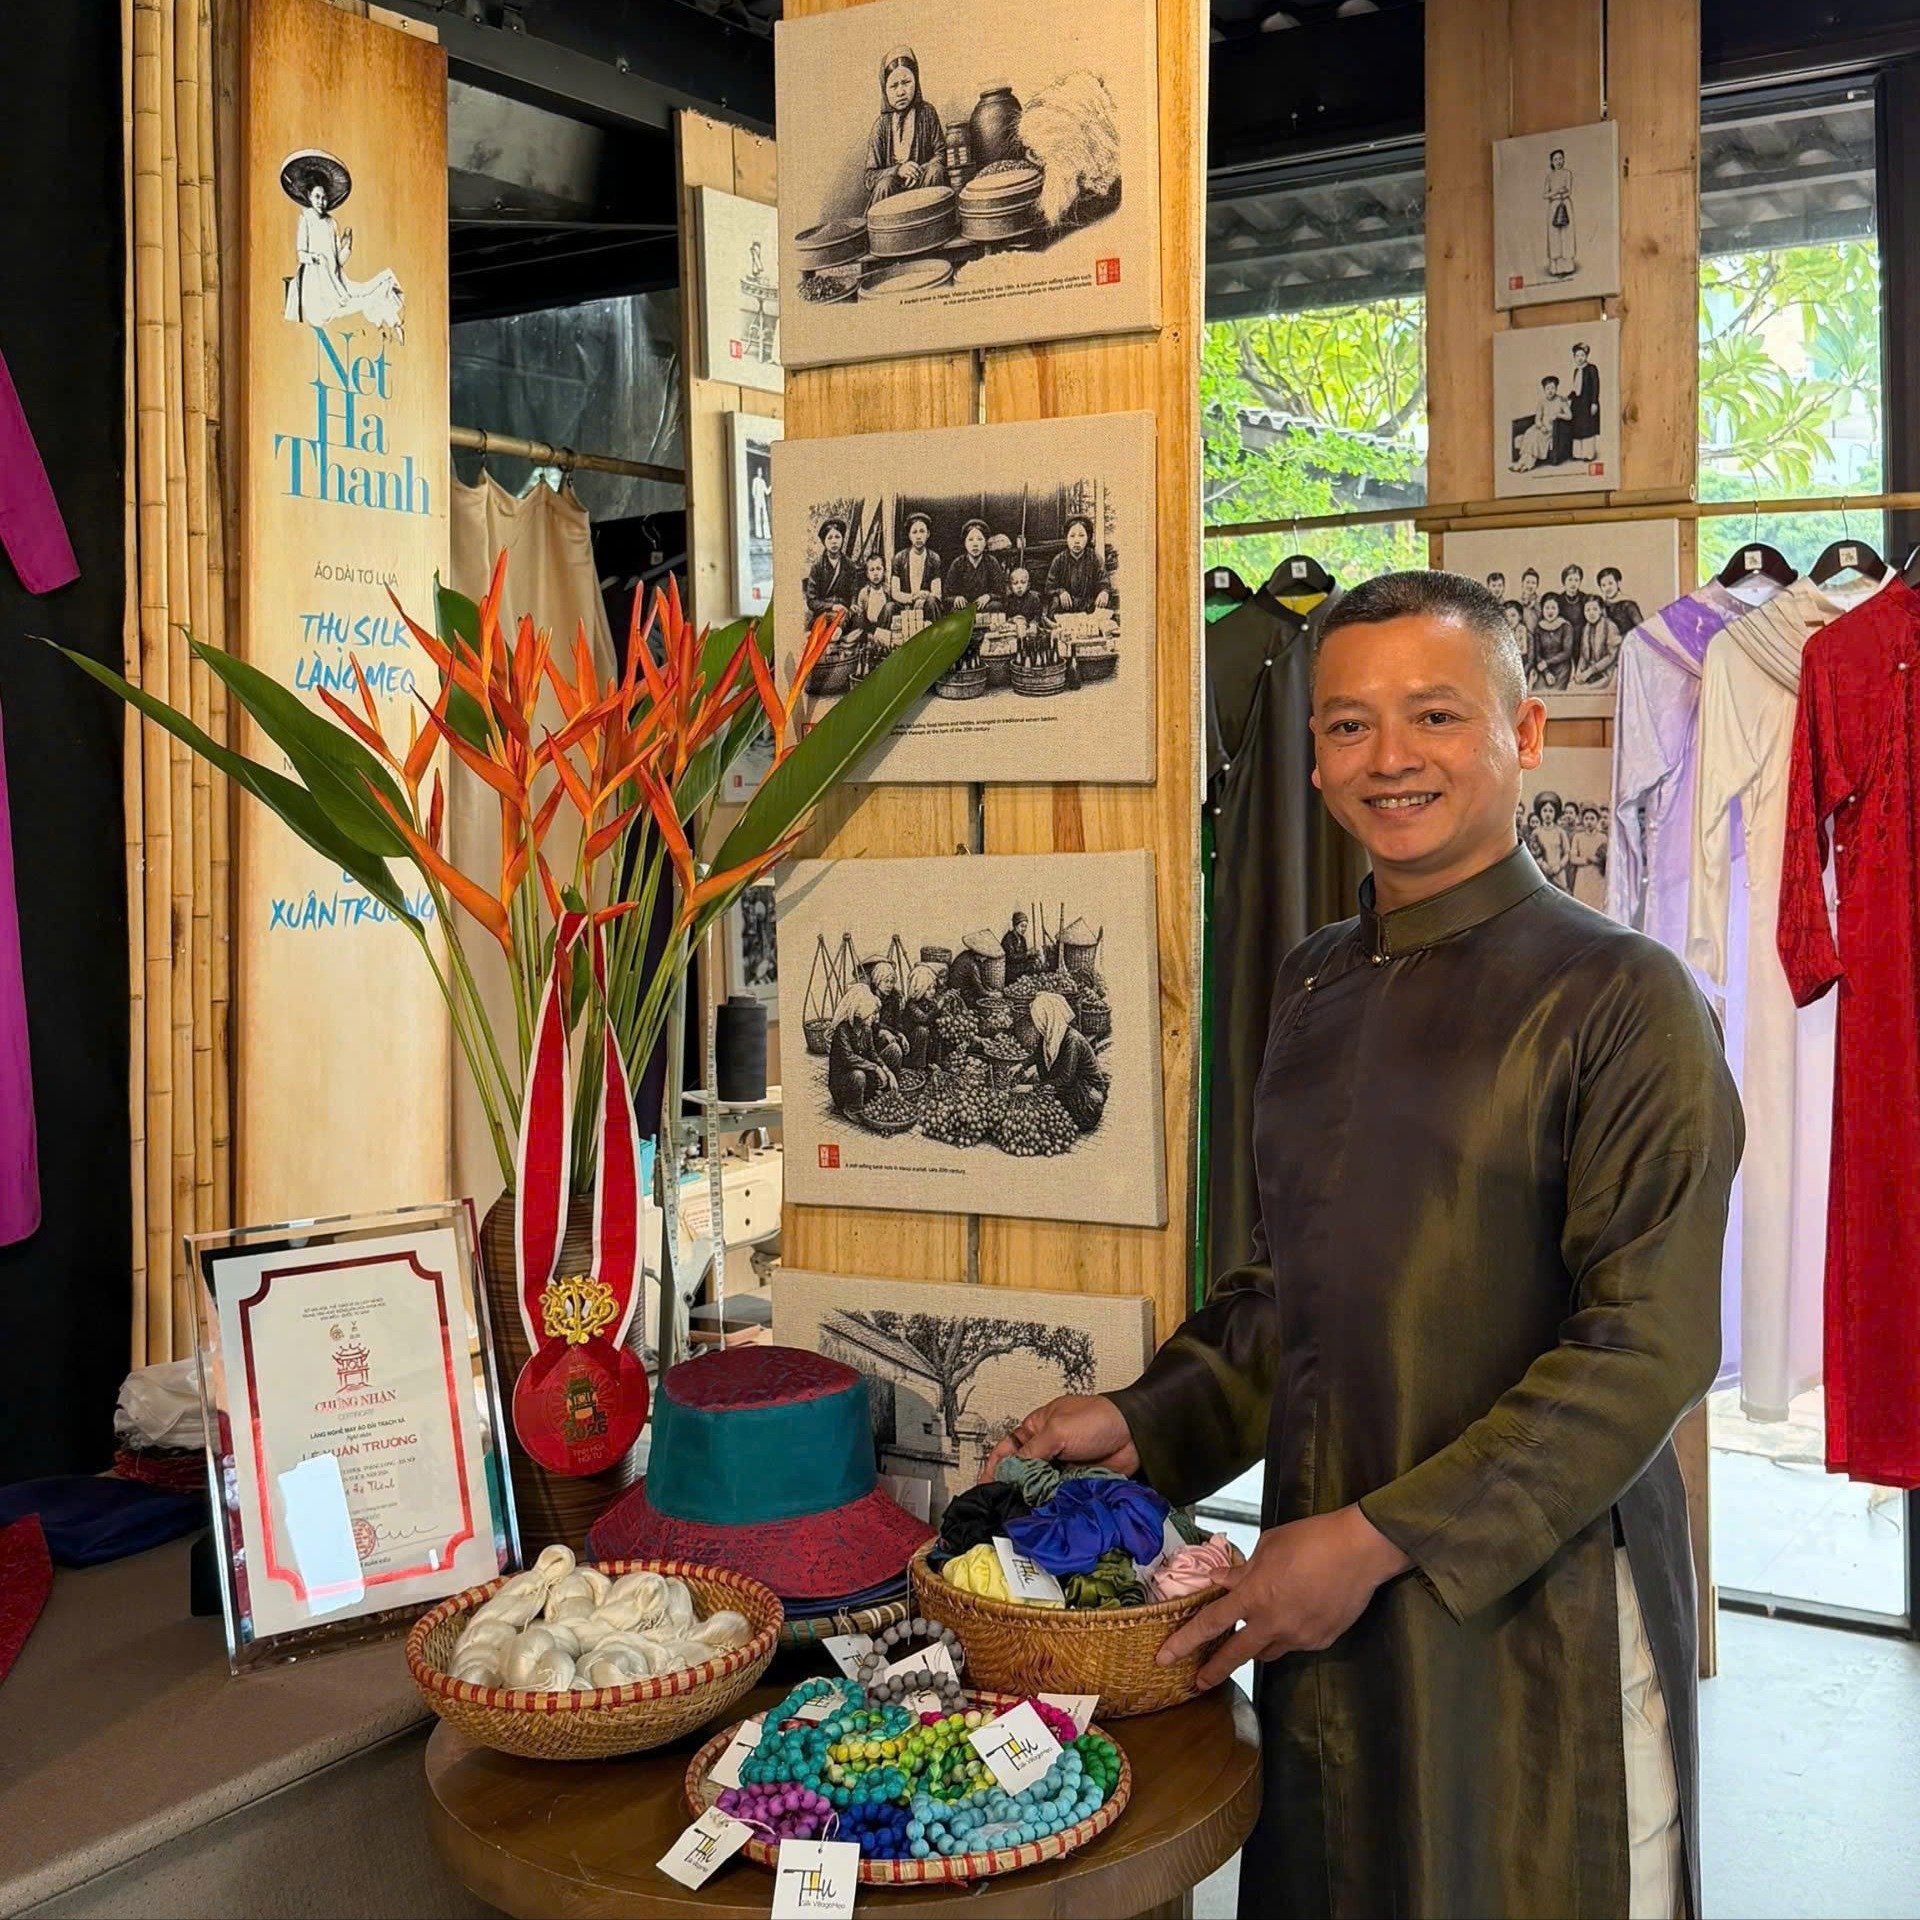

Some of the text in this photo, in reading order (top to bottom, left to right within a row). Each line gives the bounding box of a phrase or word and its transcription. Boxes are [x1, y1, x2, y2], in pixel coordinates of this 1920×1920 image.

[309, 324, 393, 400] Net
[309, 378, 391, 456] Ha
[274, 434, 432, 515] Thanh
[299, 611, 410, 653] THỤ SILK
[294, 650, 358, 695] LÀNG
[270, 889, 338, 931] XUÂN
